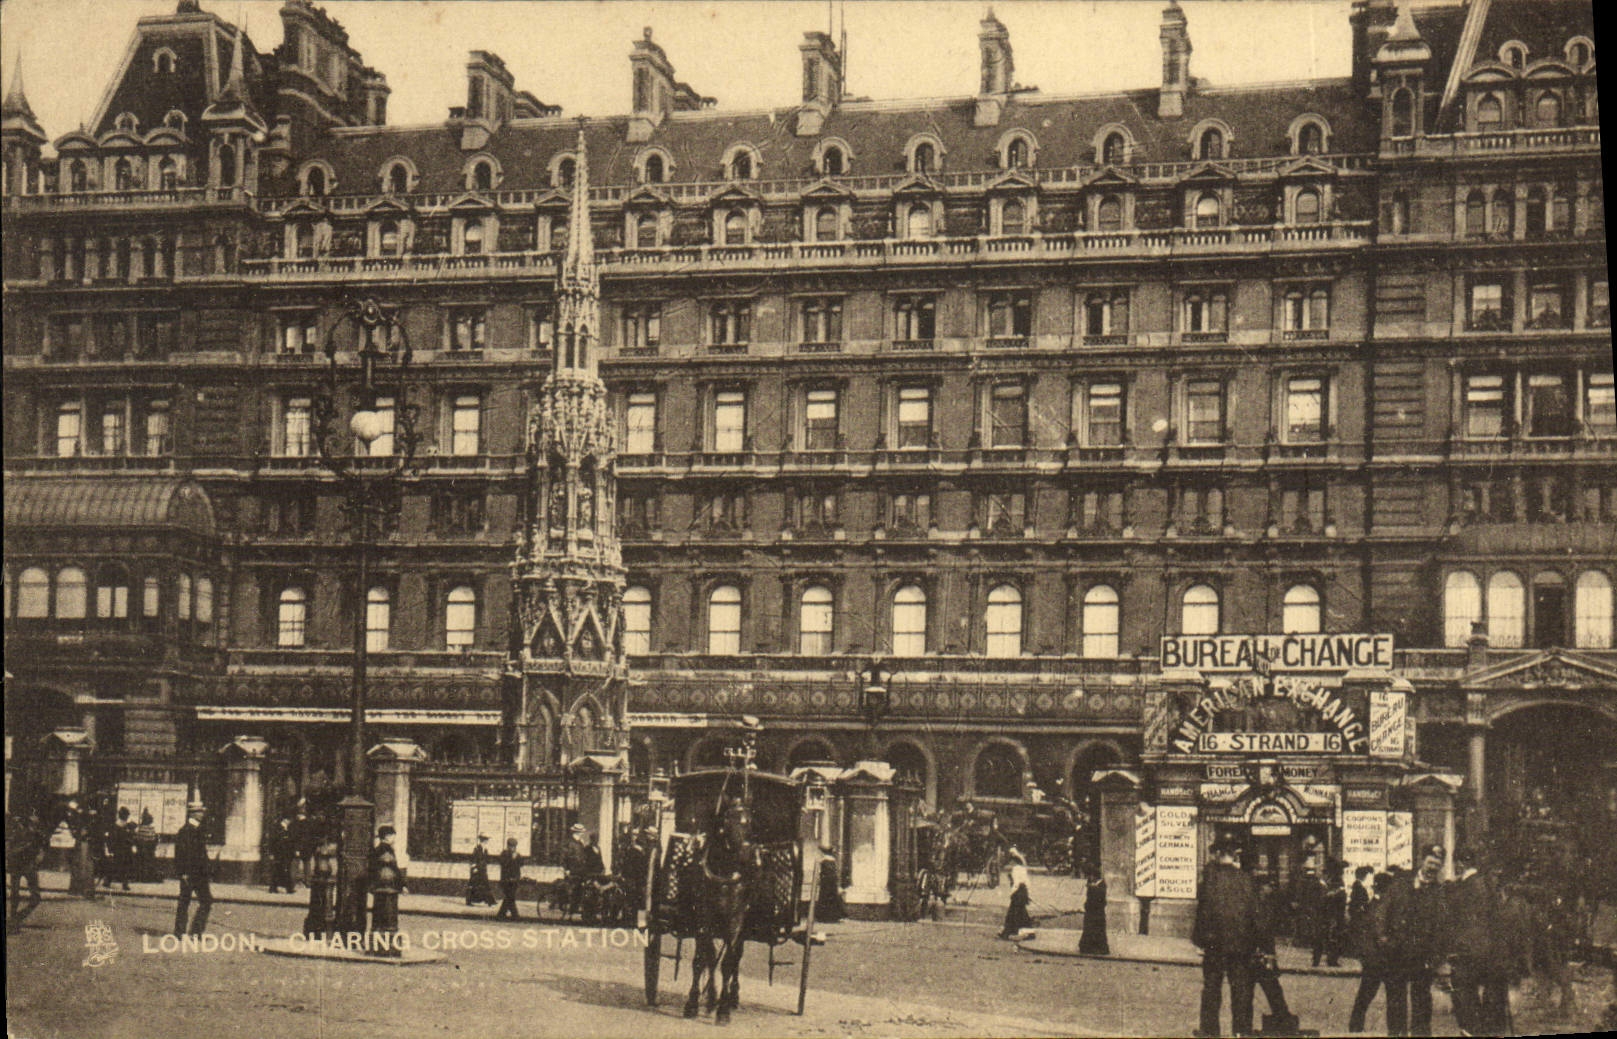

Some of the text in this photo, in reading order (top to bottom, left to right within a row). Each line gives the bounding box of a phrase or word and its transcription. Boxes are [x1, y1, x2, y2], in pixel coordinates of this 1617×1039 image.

[1282, 636, 1390, 668] CHANGE
[1174, 676, 1265, 755] AMERICAN
[1273, 676, 1370, 753] EXCHANGE
[1202, 733, 1341, 750] 16 STRAND 16
